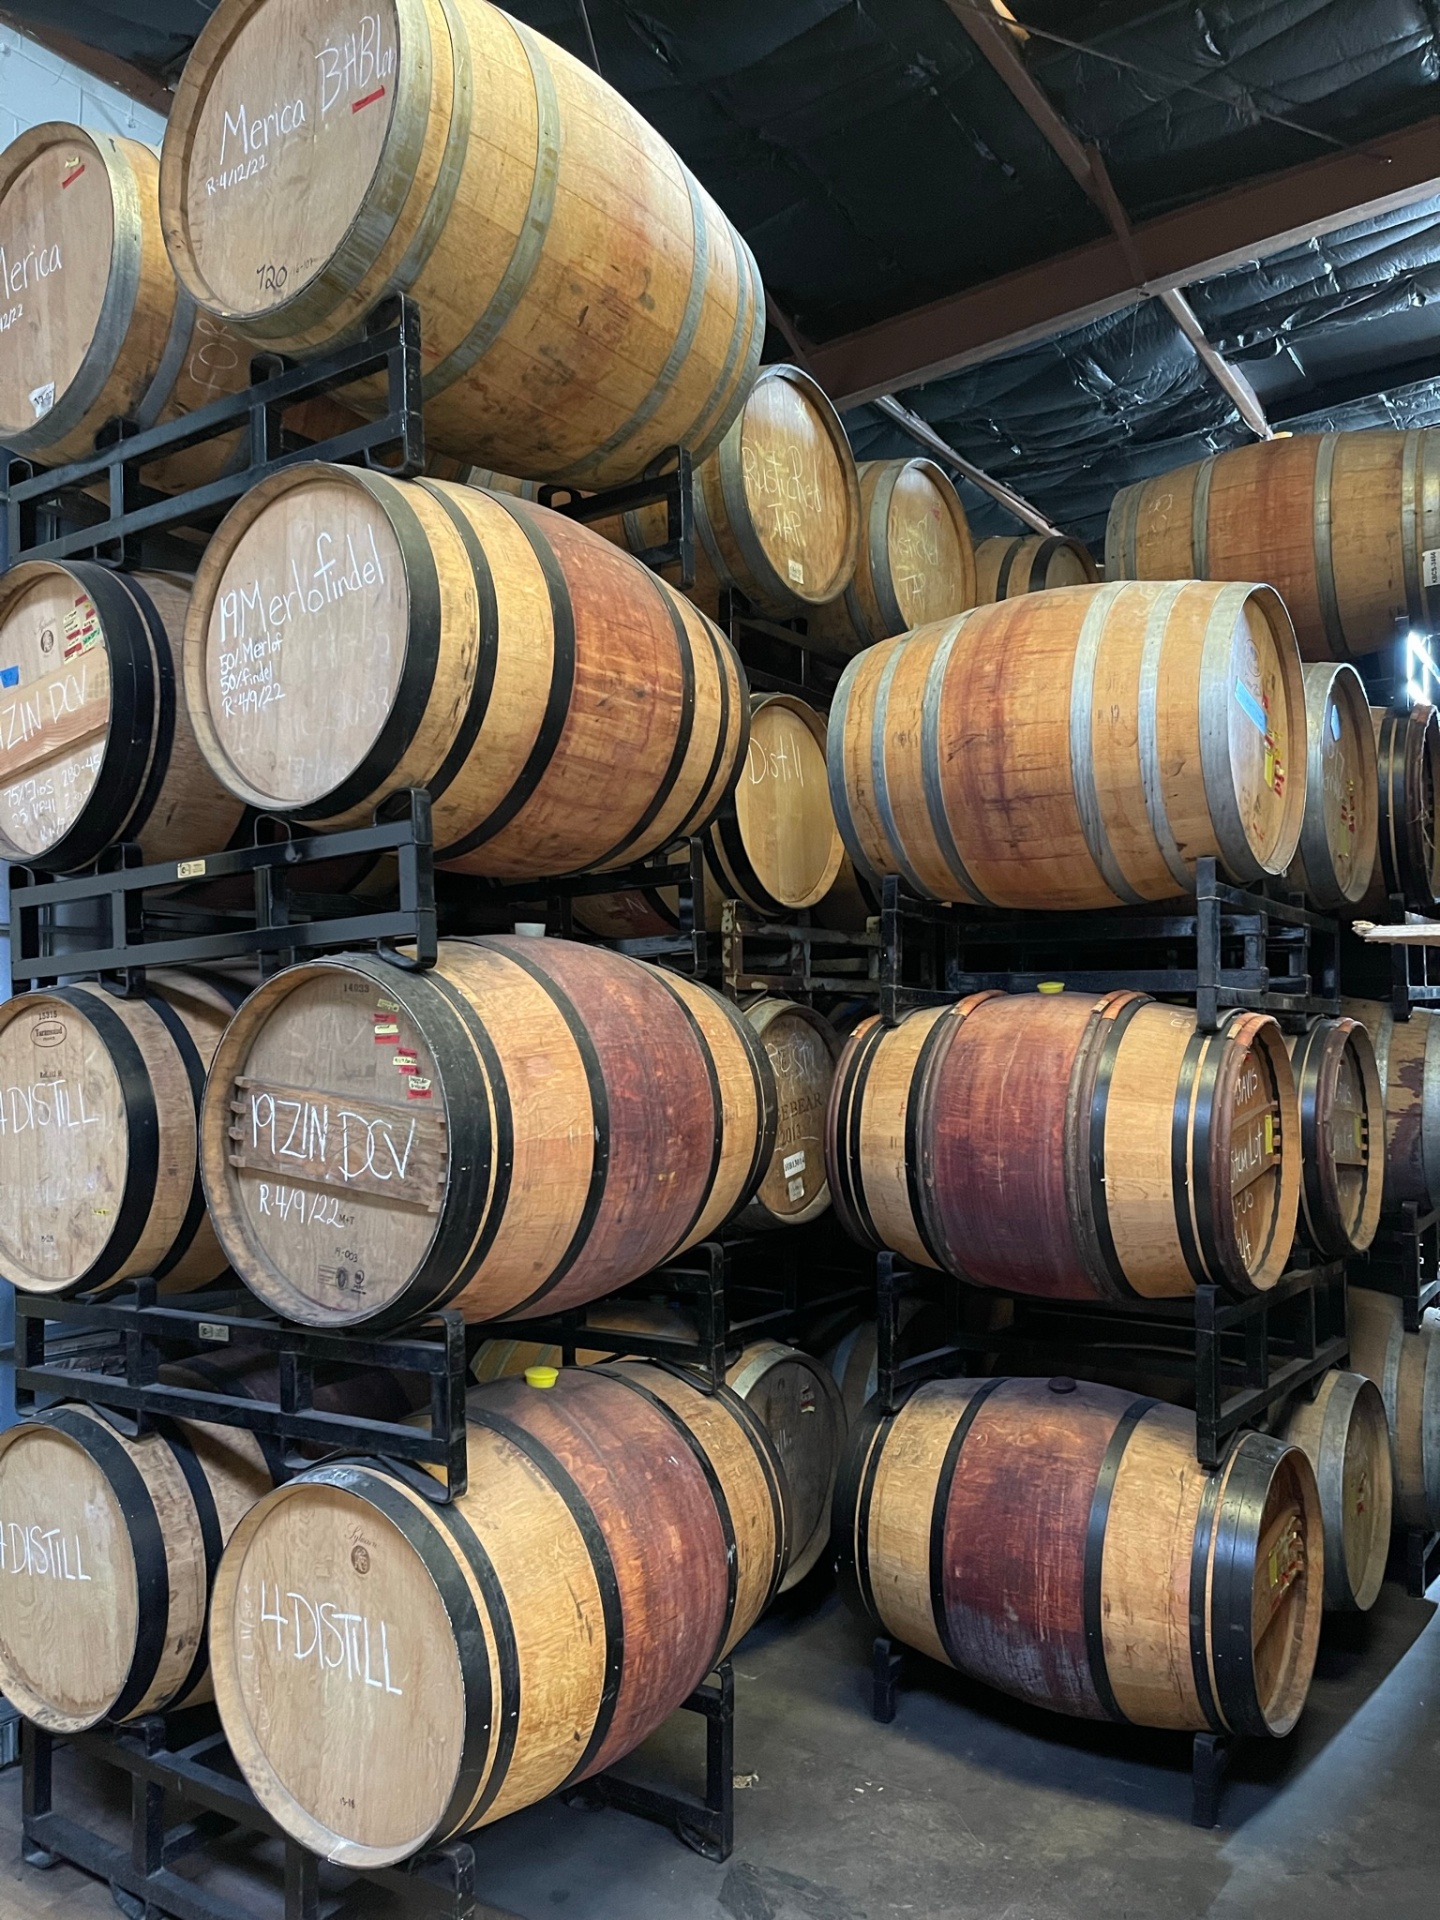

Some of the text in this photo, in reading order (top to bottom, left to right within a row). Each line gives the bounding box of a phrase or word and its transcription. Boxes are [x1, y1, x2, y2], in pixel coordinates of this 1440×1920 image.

[219, 99, 306, 166] Merica
[337, 1111, 417, 1182] DCV
[259, 1183, 345, 1229] R:4/9/22
